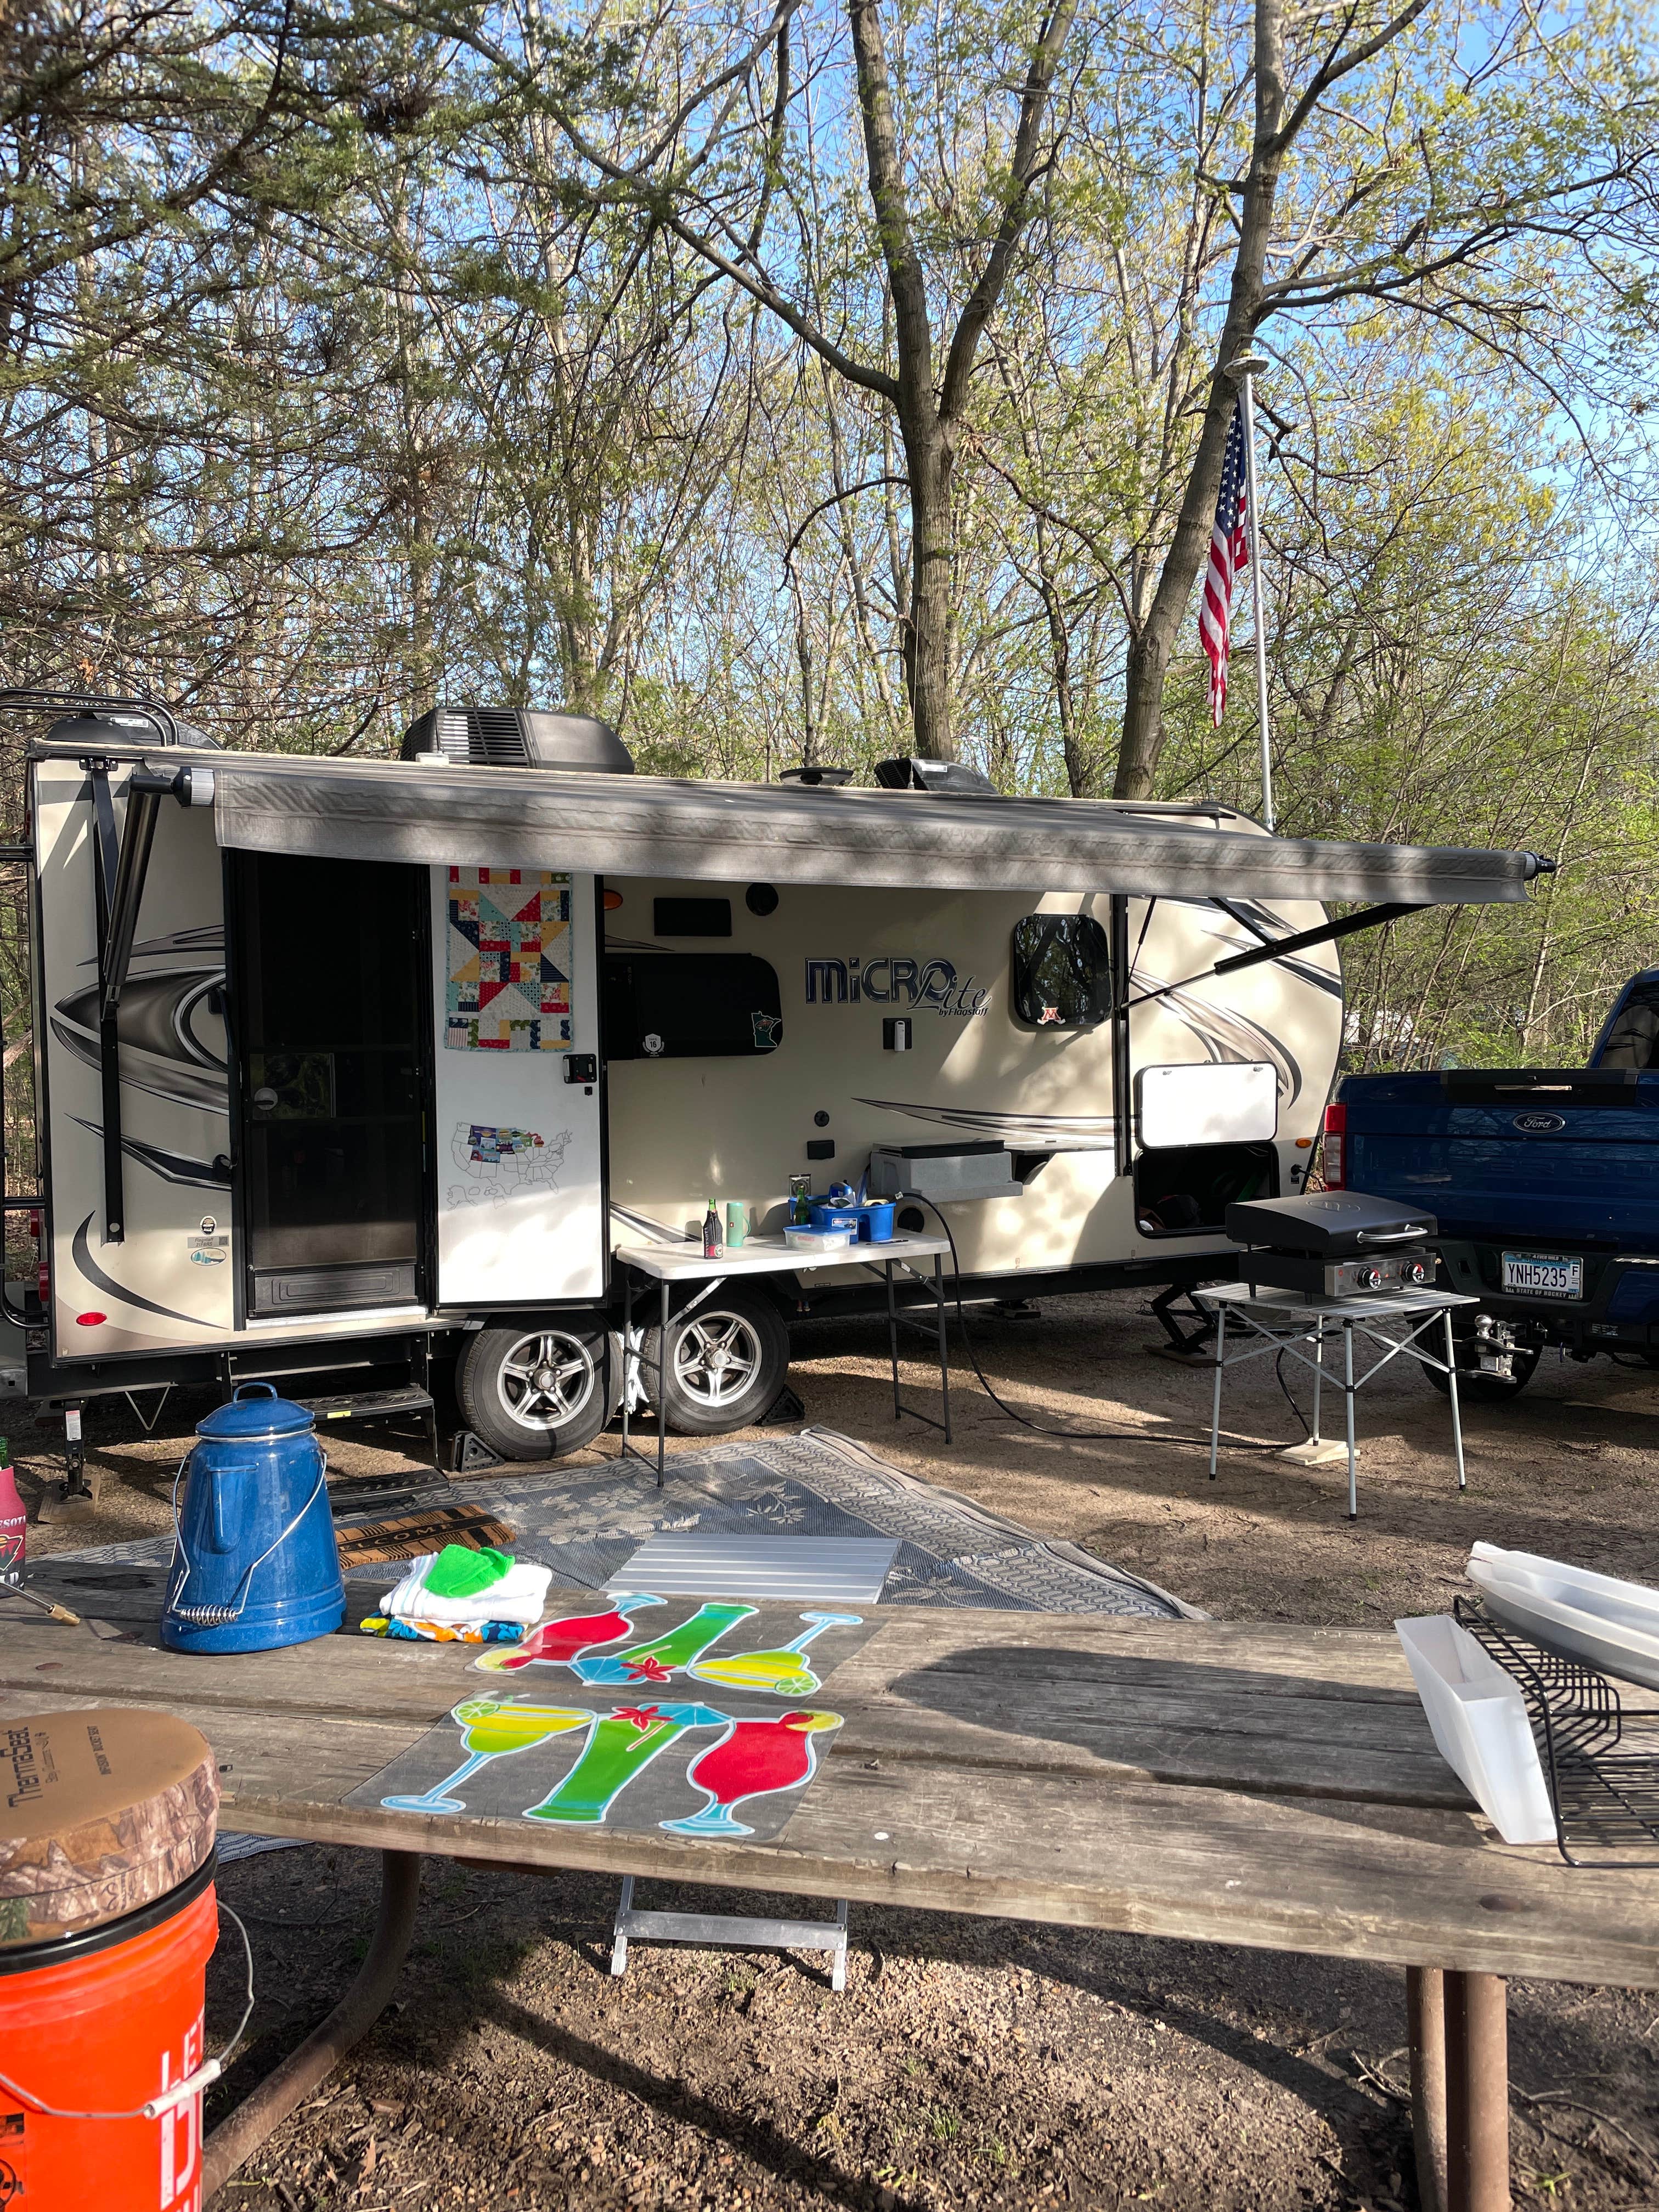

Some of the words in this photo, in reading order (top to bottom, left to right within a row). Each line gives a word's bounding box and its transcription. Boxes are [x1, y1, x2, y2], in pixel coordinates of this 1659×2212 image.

[906, 968, 991, 1011] Lite
[1524, 1116, 1551, 1128] Ford
[1508, 1263, 1567, 1288] YNH5235
[1572, 1266, 1579, 1276] F
